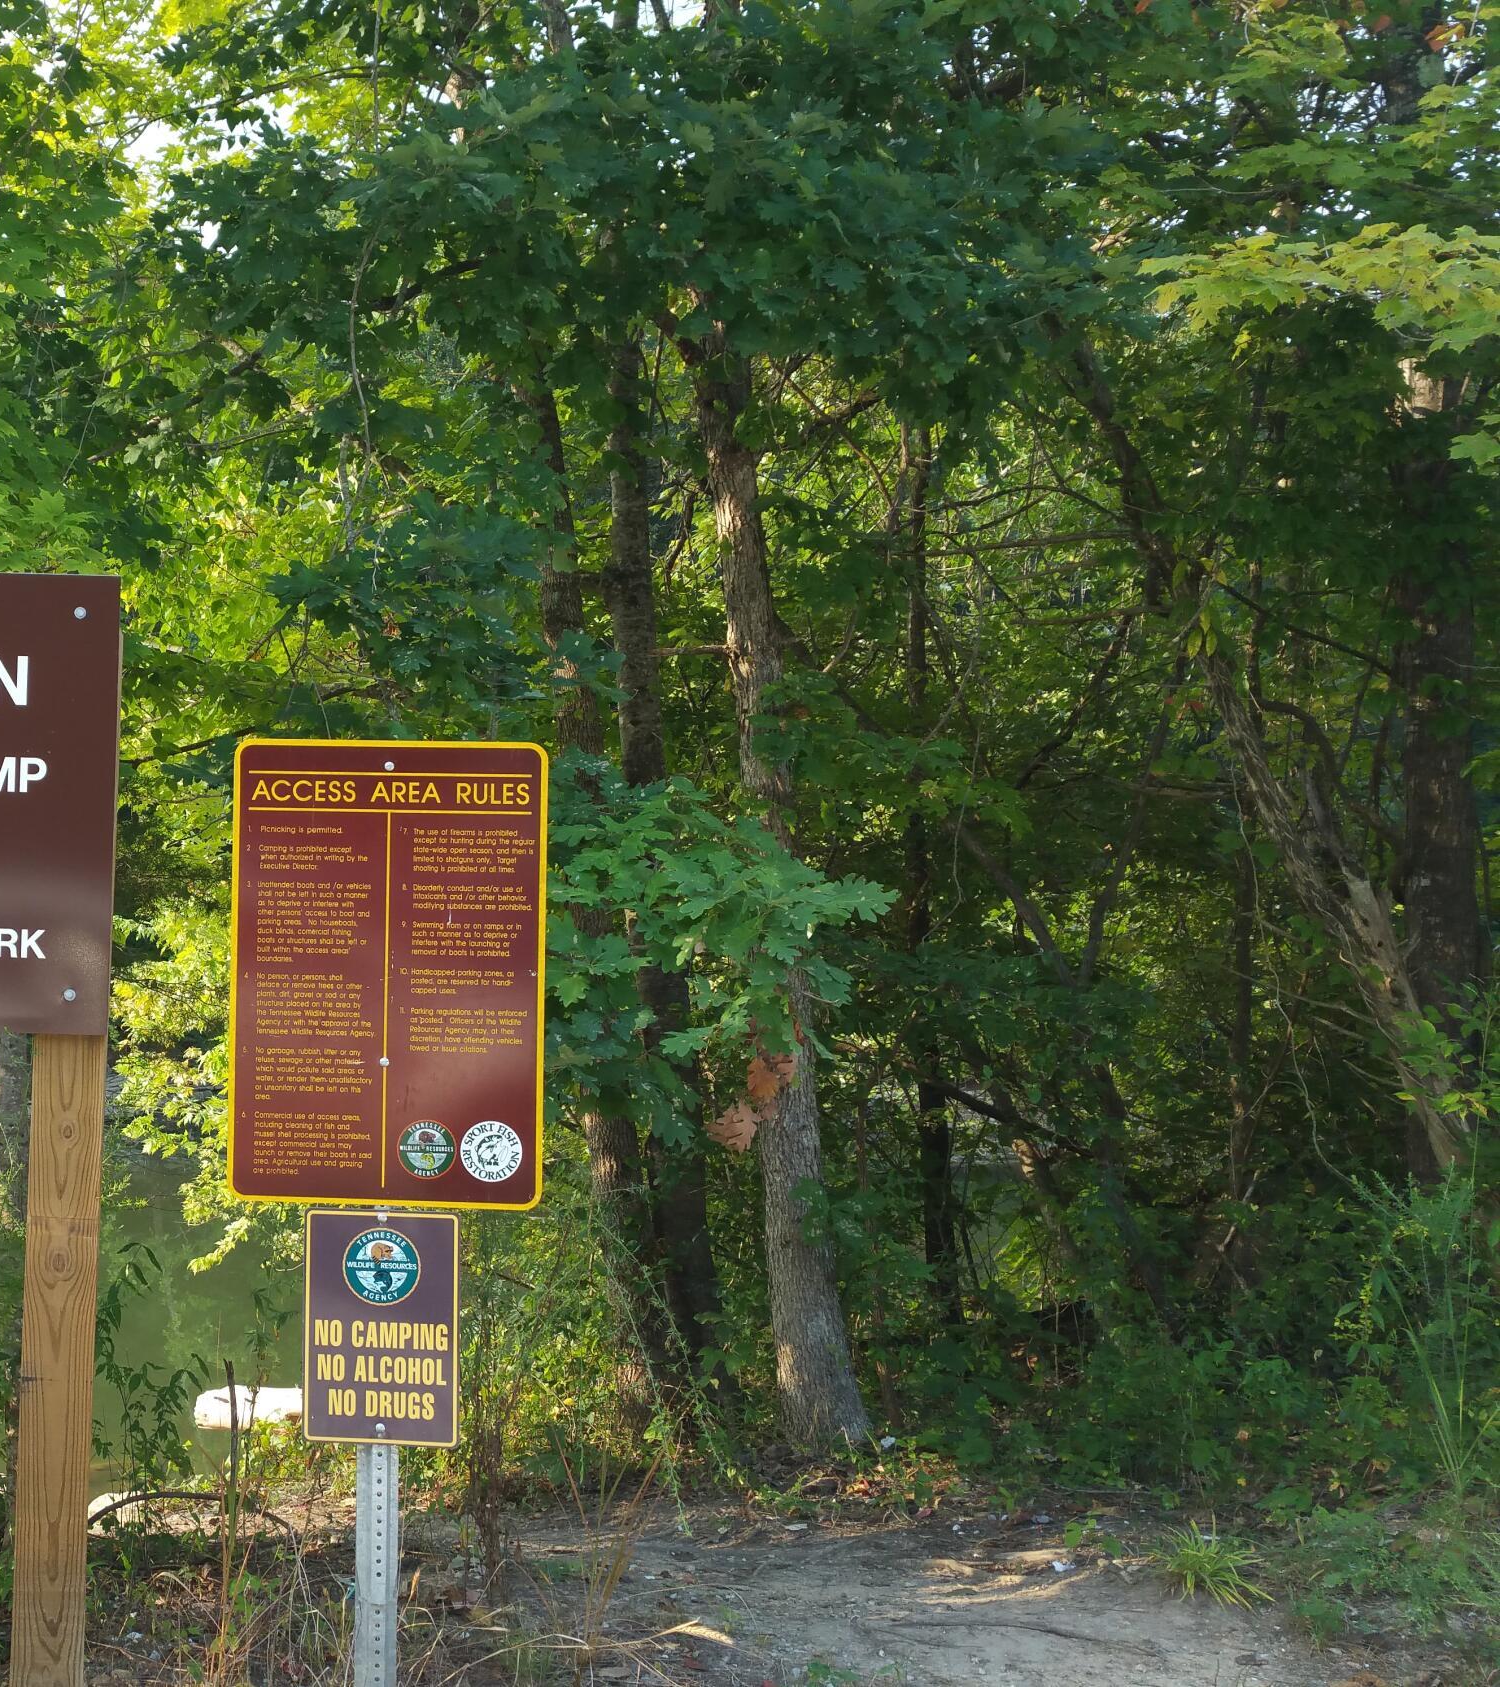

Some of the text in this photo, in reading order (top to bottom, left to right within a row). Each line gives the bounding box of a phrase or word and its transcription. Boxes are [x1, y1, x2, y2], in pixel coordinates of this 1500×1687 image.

[252, 780, 529, 805] ACCESS AREA RULES
[260, 825, 297, 835] Picnicking
[414, 827, 425, 836] The
[440, 827, 448, 836] of
[450, 828, 476, 836] firearms
[485, 828, 519, 839] prohibited
[413, 836, 536, 848] except for hunting during the regular
[258, 843, 288, 854] Camping
[296, 844, 328, 854] prohibited
[329, 844, 352, 855] except
[449, 848, 468, 856] open
[496, 846, 510, 855] and
[511, 847, 527, 855] then
[260, 852, 278, 861] when
[279, 852, 314, 861] authorized
[324, 853, 345, 863] writing
[346, 853, 356, 864] by
[357, 853, 368, 862] the
[436, 855, 444, 863] to
[446, 855, 474, 866] shotguns
[497, 855, 517, 866] Target
[260, 861, 290, 870] Executive
[413, 864, 439, 874] shooting
[447, 864, 478, 875] prohibited
[479, 864, 487, 873] at
[488, 864, 497, 873] all
[296, 881, 315, 889] boats
[317, 881, 331, 890] and
[346, 882, 372, 890] vehicles
[412, 883, 445, 894] Disorderly
[446, 884, 474, 892] conduct
[515, 885, 523, 893] of
[413, 892, 447, 901] intoxicants
[450, 892, 463, 901] and
[478, 893, 495, 901] other
[498, 893, 527, 902] behavior
[413, 901, 445, 912] modifying
[447, 902, 483, 911] substances
[257, 917, 282, 927] parking
[308, 918, 318, 926] No
[411, 948, 438, 956] removal
[439, 948, 447, 957] of
[448, 948, 468, 957] boats
[257, 972, 266, 980] No
[329, 973, 343, 981] shall
[411, 968, 456, 979] Handicapped
[458, 968, 482, 979] parking
[450, 978, 479, 986] reserved
[481, 978, 490, 987] for
[411, 986, 437, 997] capped
[256, 1064, 274, 1073] which
[277, 1065, 295, 1073] would
[297, 1065, 319, 1076] pollute
[322, 1065, 335, 1074] said
[254, 1111, 293, 1120] Commercial
[307, 1112, 315, 1121] of
[277, 1130, 292, 1139] shell
[293, 1131, 329, 1141] processing
[465, 1123, 519, 1147] SPORT FISH
[462, 1149, 520, 1180] RESTORATION
[357, 1232, 406, 1247] TENNESSEE
[347, 1261, 375, 1269] WILDLIFE
[363, 1290, 398, 1301] AGENCY
[315, 1319, 448, 1351] NO CAMPING
[317, 1354, 447, 1386] NO ALCOHOL
[329, 1389, 434, 1420] NO DRUGS
